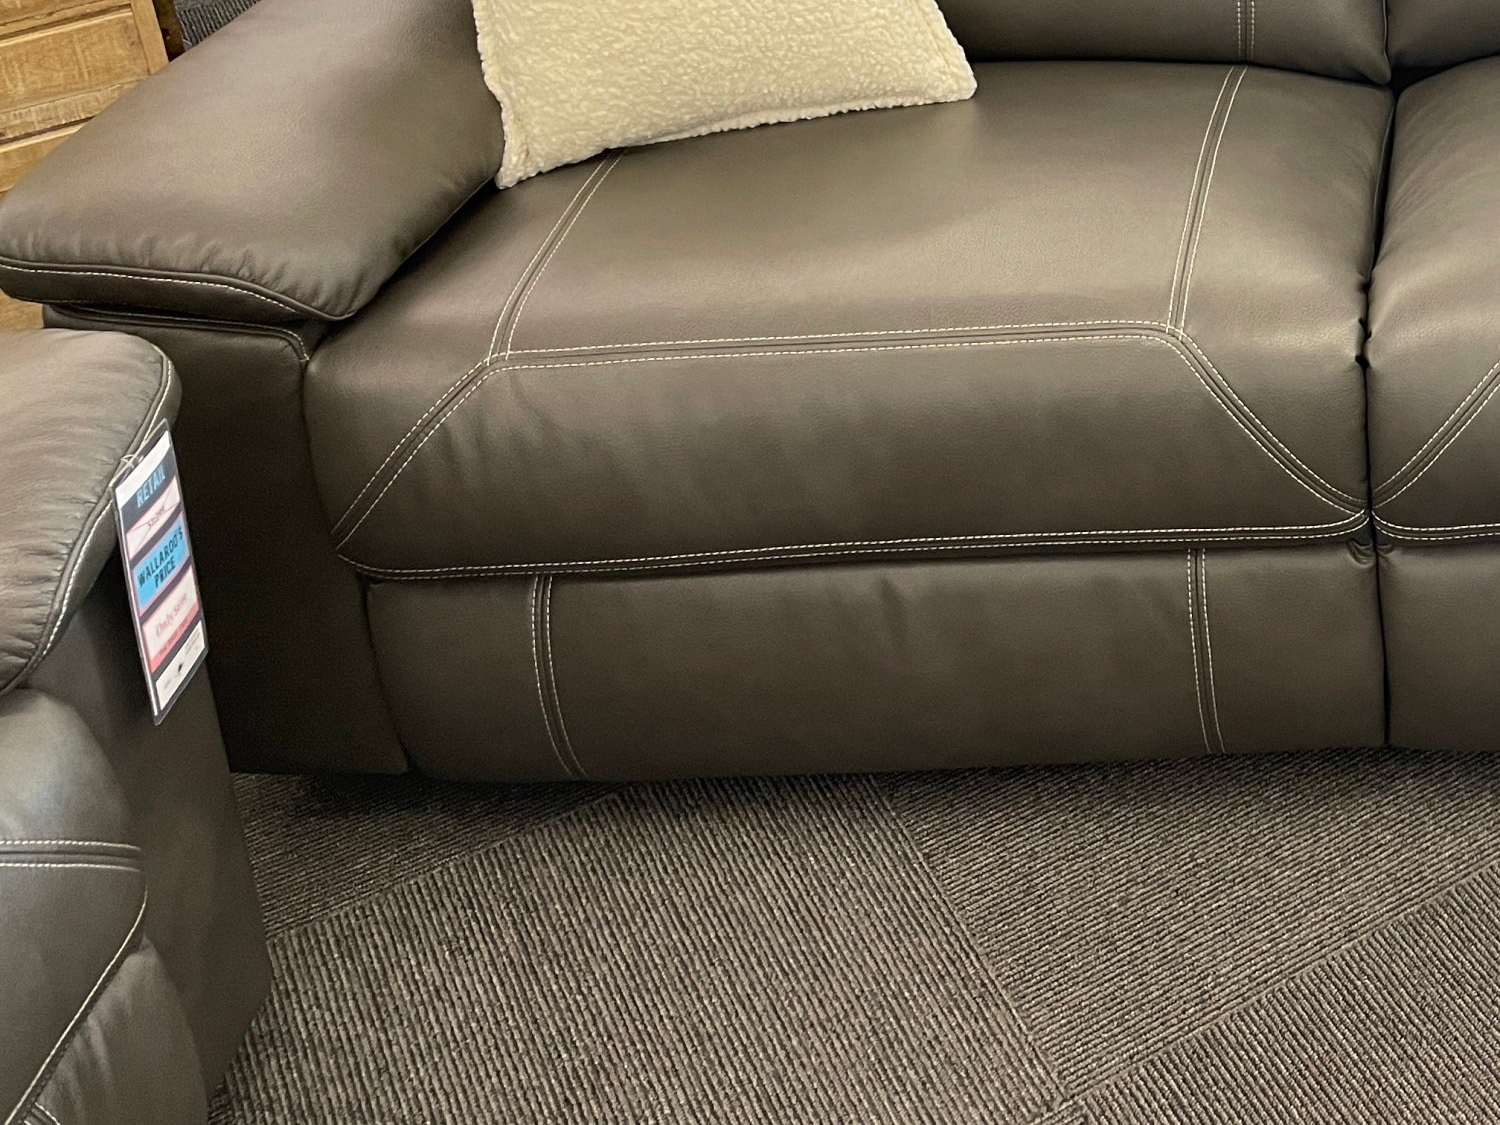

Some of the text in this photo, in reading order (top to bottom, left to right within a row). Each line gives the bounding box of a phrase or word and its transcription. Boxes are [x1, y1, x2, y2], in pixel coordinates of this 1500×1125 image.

[136, 462, 166, 509] RETAIL
[137, 526, 184, 588] WALLAROO'S
[154, 557, 176, 589] PRICE
